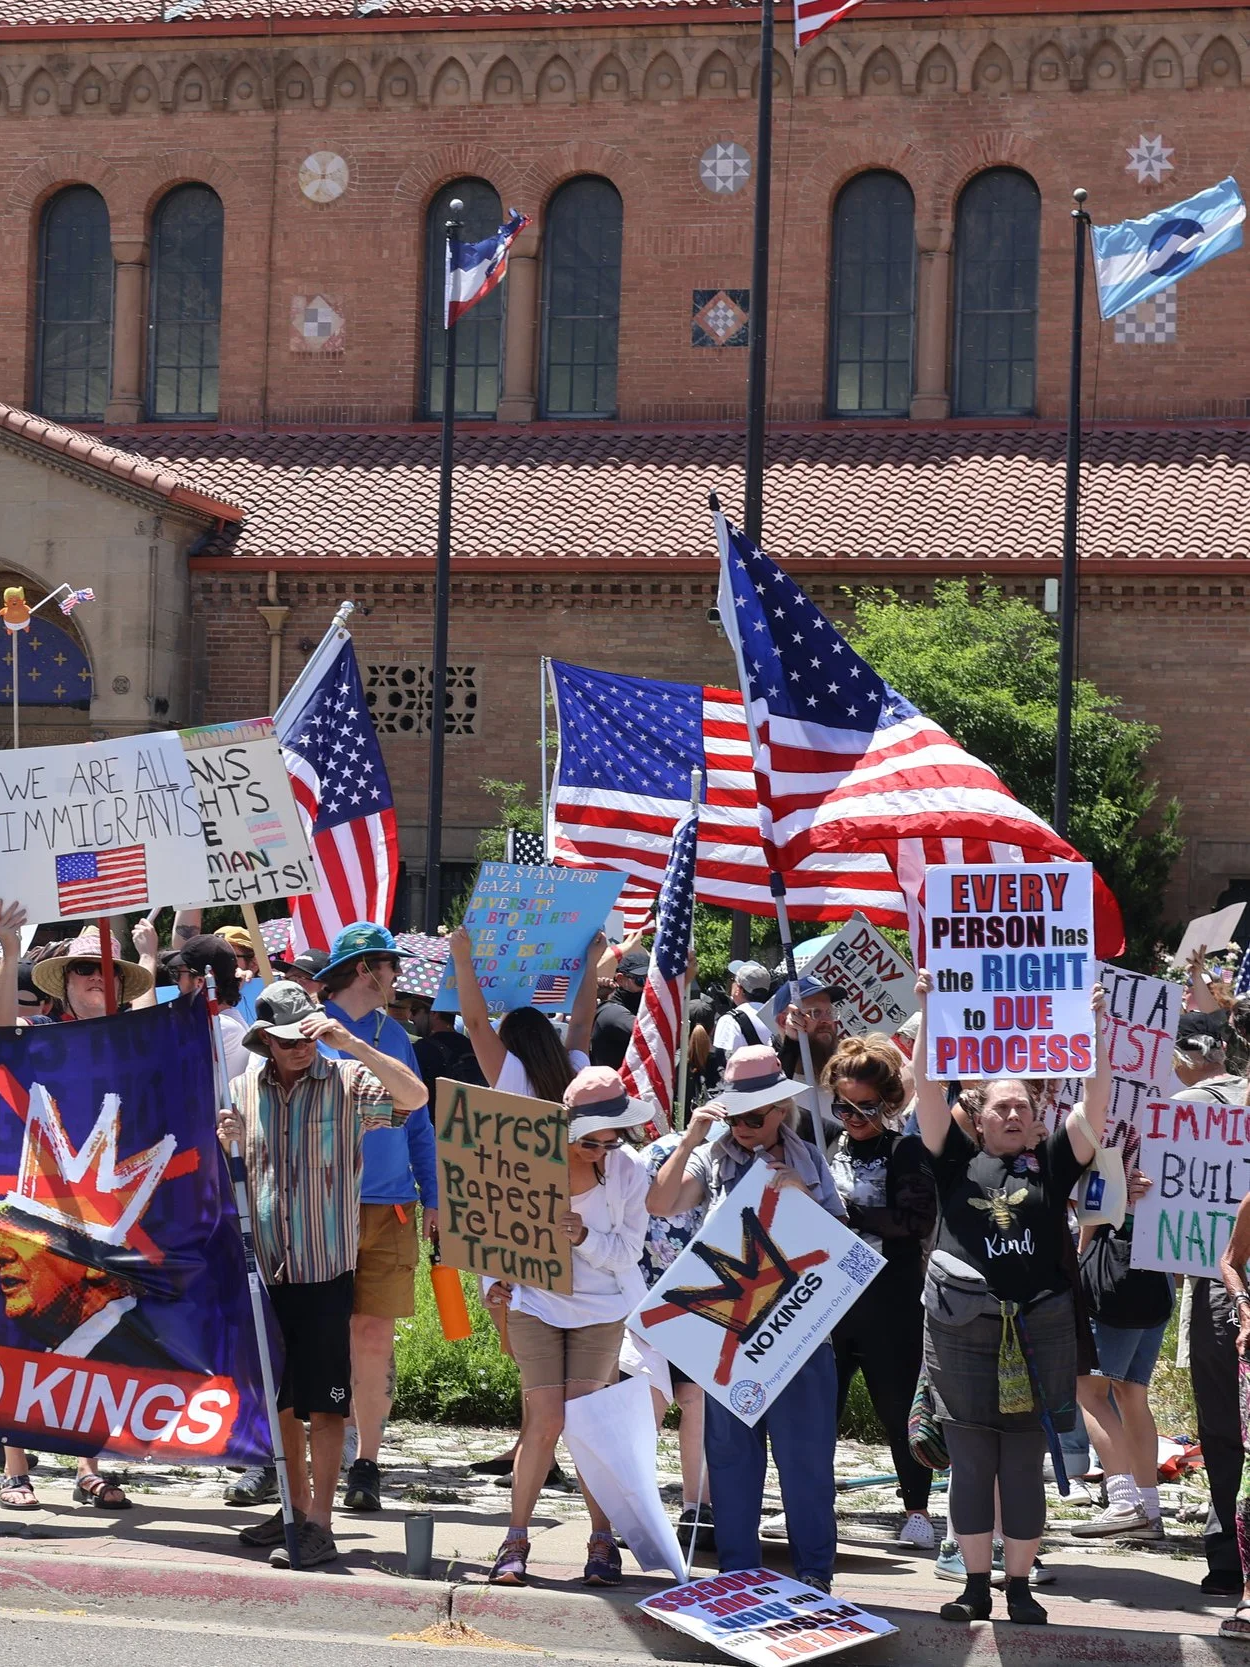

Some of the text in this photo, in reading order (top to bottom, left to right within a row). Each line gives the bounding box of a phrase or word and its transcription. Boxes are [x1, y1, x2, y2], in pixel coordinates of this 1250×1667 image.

[0, 747, 179, 800] WE ARE ALL
[185, 748, 251, 785] ANS
[198, 781, 271, 819] HTS
[207, 849, 269, 874] MAN
[209, 861, 309, 902] IGHTS!
[484, 866, 598, 884] WE STAND FOR
[471, 897, 556, 912] DIVERSITY
[478, 881, 521, 893] GAZA
[951, 873, 1069, 913] EVERY
[467, 911, 580, 926] LBTQ RIHTS
[470, 928, 527, 941] CIECE
[931, 915, 1088, 949] PERSON has
[472, 958, 581, 972] TIOAL ARKS
[849, 928, 904, 982] DENY
[937, 952, 1088, 992] the RIGHT
[815, 954, 883, 1024] DEFEND
[1146, 985, 1169, 1029] A
[963, 995, 1053, 1030] to DUE
[936, 1034, 1091, 1074] PROCESS
[439, 1087, 569, 1165] Arrest
[1146, 1103, 1250, 1146] IMMI
[474, 1144, 530, 1185] the
[442, 1158, 563, 1224] Rapest
[447, 1198, 558, 1254] FeLon
[984, 1228, 1035, 1259] Kind
[461, 1235, 562, 1290] Trump
[744, 1331, 775, 1364] NO
[774, 1272, 823, 1334] KINGS
[764, 1355, 789, 1390] Progress
[787, 1342, 803, 1360] from
[801, 1328, 814, 1346] the
[810, 1306, 834, 1335] Bottom
[831, 1295, 844, 1310] On
[14, 1359, 235, 1446] KINGS
[646, 1569, 783, 1612] PROCESS
[700, 1586, 779, 1617] to DUE
[786, 1592, 823, 1605] the
[724, 1604, 862, 1647] PERSON has
[766, 1621, 874, 1660] EVERY
